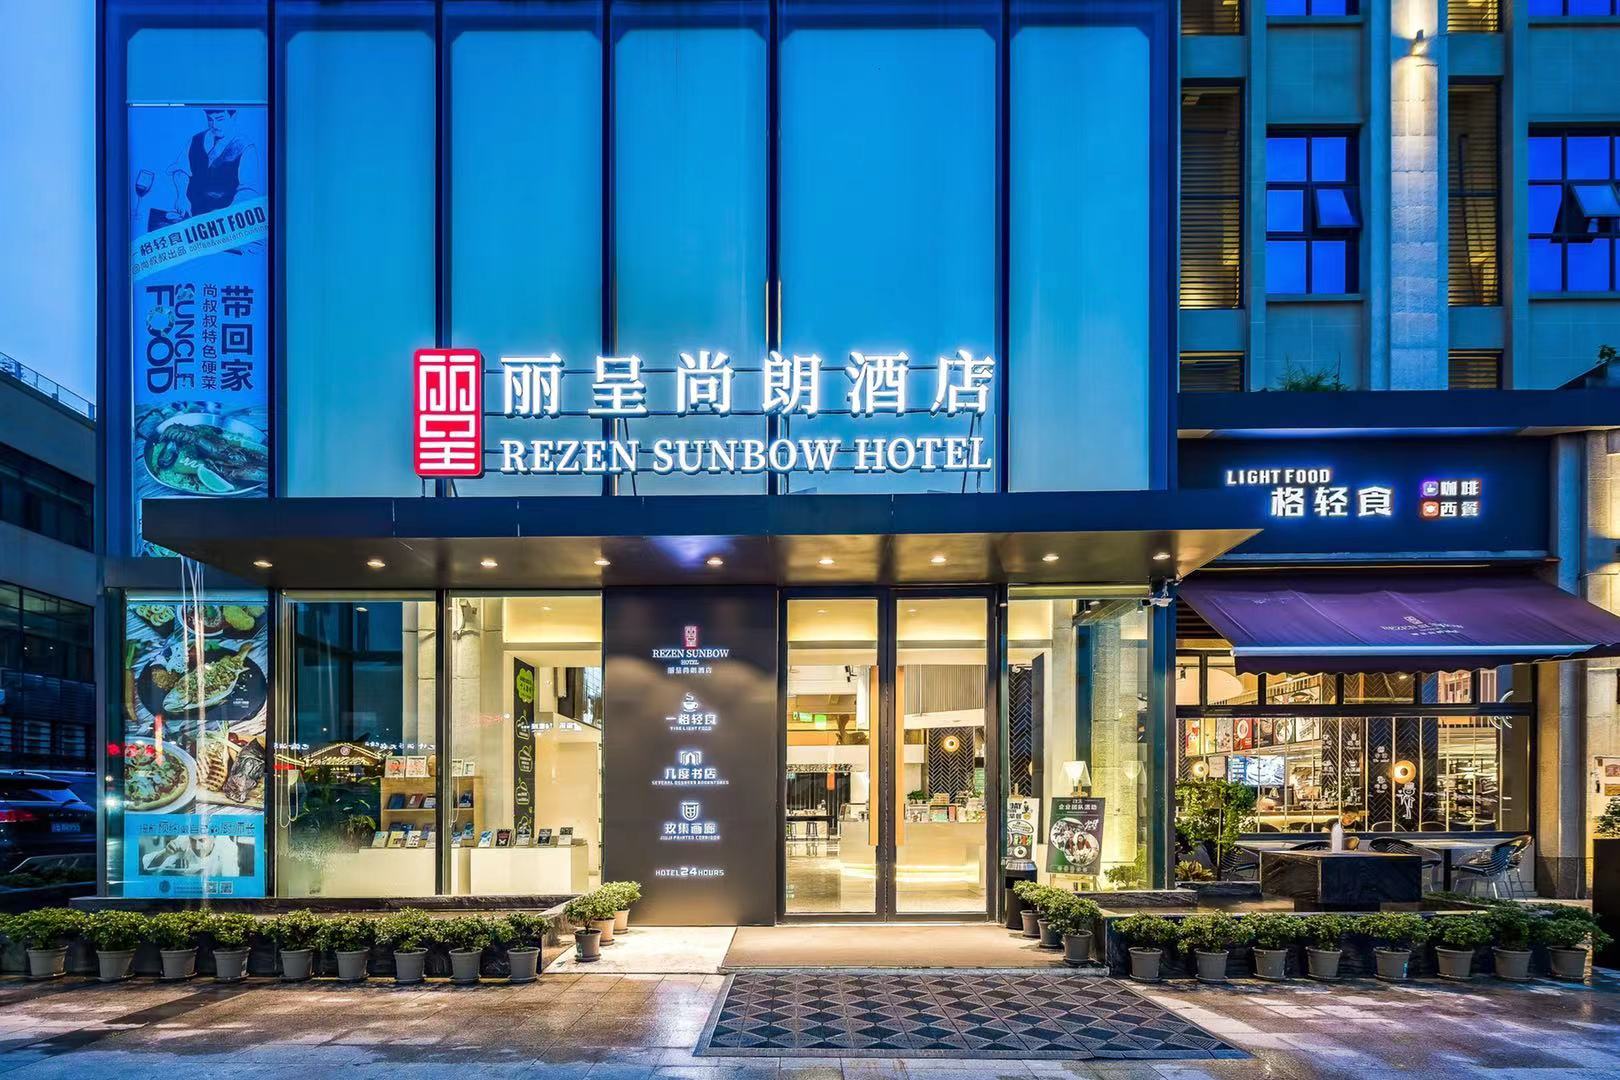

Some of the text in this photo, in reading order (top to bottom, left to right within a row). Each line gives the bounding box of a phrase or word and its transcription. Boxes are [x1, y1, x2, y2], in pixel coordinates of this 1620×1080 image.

[184, 217, 227, 244] LIGHT
[227, 206, 266, 232] FOOD
[146, 285, 175, 394] FOOD
[202, 283, 218, 391] 尚叔叔特色硬菜
[220, 285, 254, 392] 带回家
[500, 350, 995, 419] 丽呈尚朗酒店
[500, 436, 992, 475] REZEN SUNBOW HOTEL
[1226, 469, 1330, 485] LIGHT FOOD
[1440, 480, 1479, 497] 咖啡
[1270, 486, 1393, 517] 格轻食
[1440, 501, 1479, 517] 西餐
[652, 648, 729, 658] REZEN SUNBOW
[665, 767, 716, 780] 几度书店
[680, 867, 697, 876] 24
